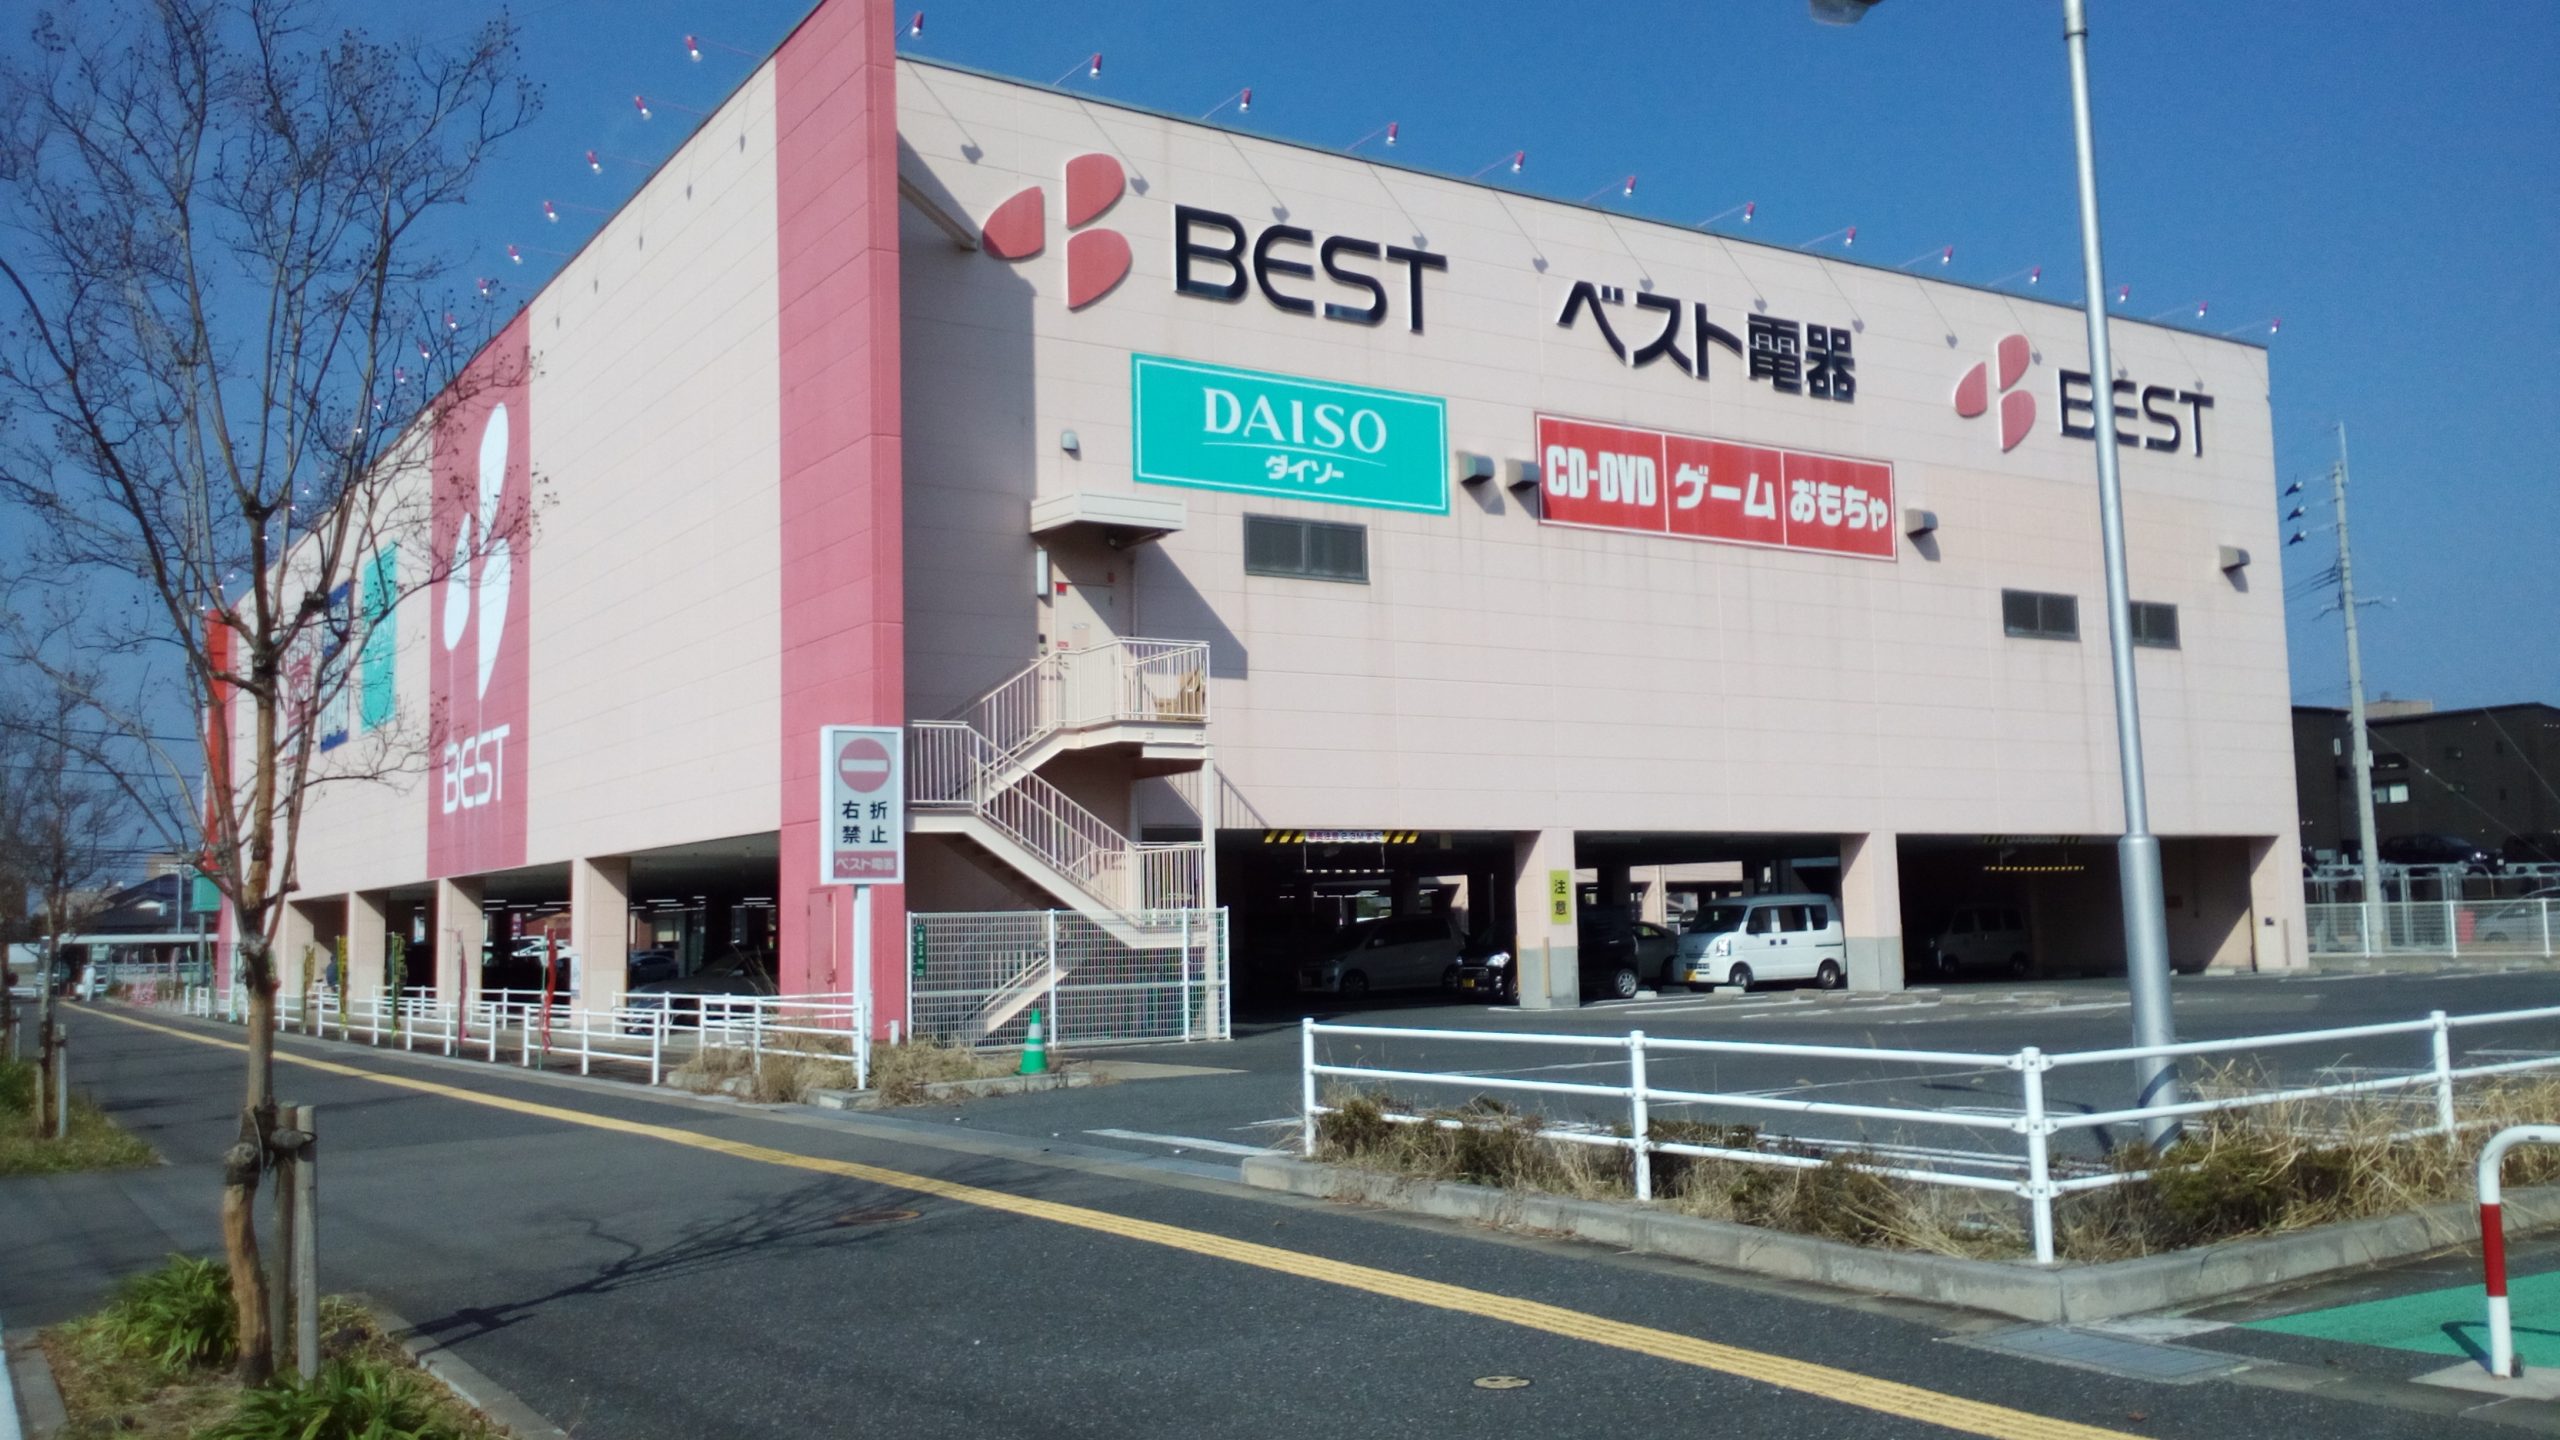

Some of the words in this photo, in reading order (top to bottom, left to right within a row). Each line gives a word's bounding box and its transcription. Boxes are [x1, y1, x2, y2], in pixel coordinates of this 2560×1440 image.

[1173, 203, 1448, 335] BEST
[1557, 280, 1856, 403] ベスト電器
[1202, 387, 1387, 453] DAISO
[2058, 368, 2214, 458] BEST
[1264, 454, 1345, 484] ダイソー
[1546, 445, 1658, 506] CD-DVD
[1674, 463, 1777, 520] ゲーム
[1789, 478, 1888, 532] おもちゃ
[443, 723, 510, 815] BEST
[842, 800, 888, 820] 右折
[842, 825, 889, 844] 禁止
[1554, 879, 1567, 915] 注意
